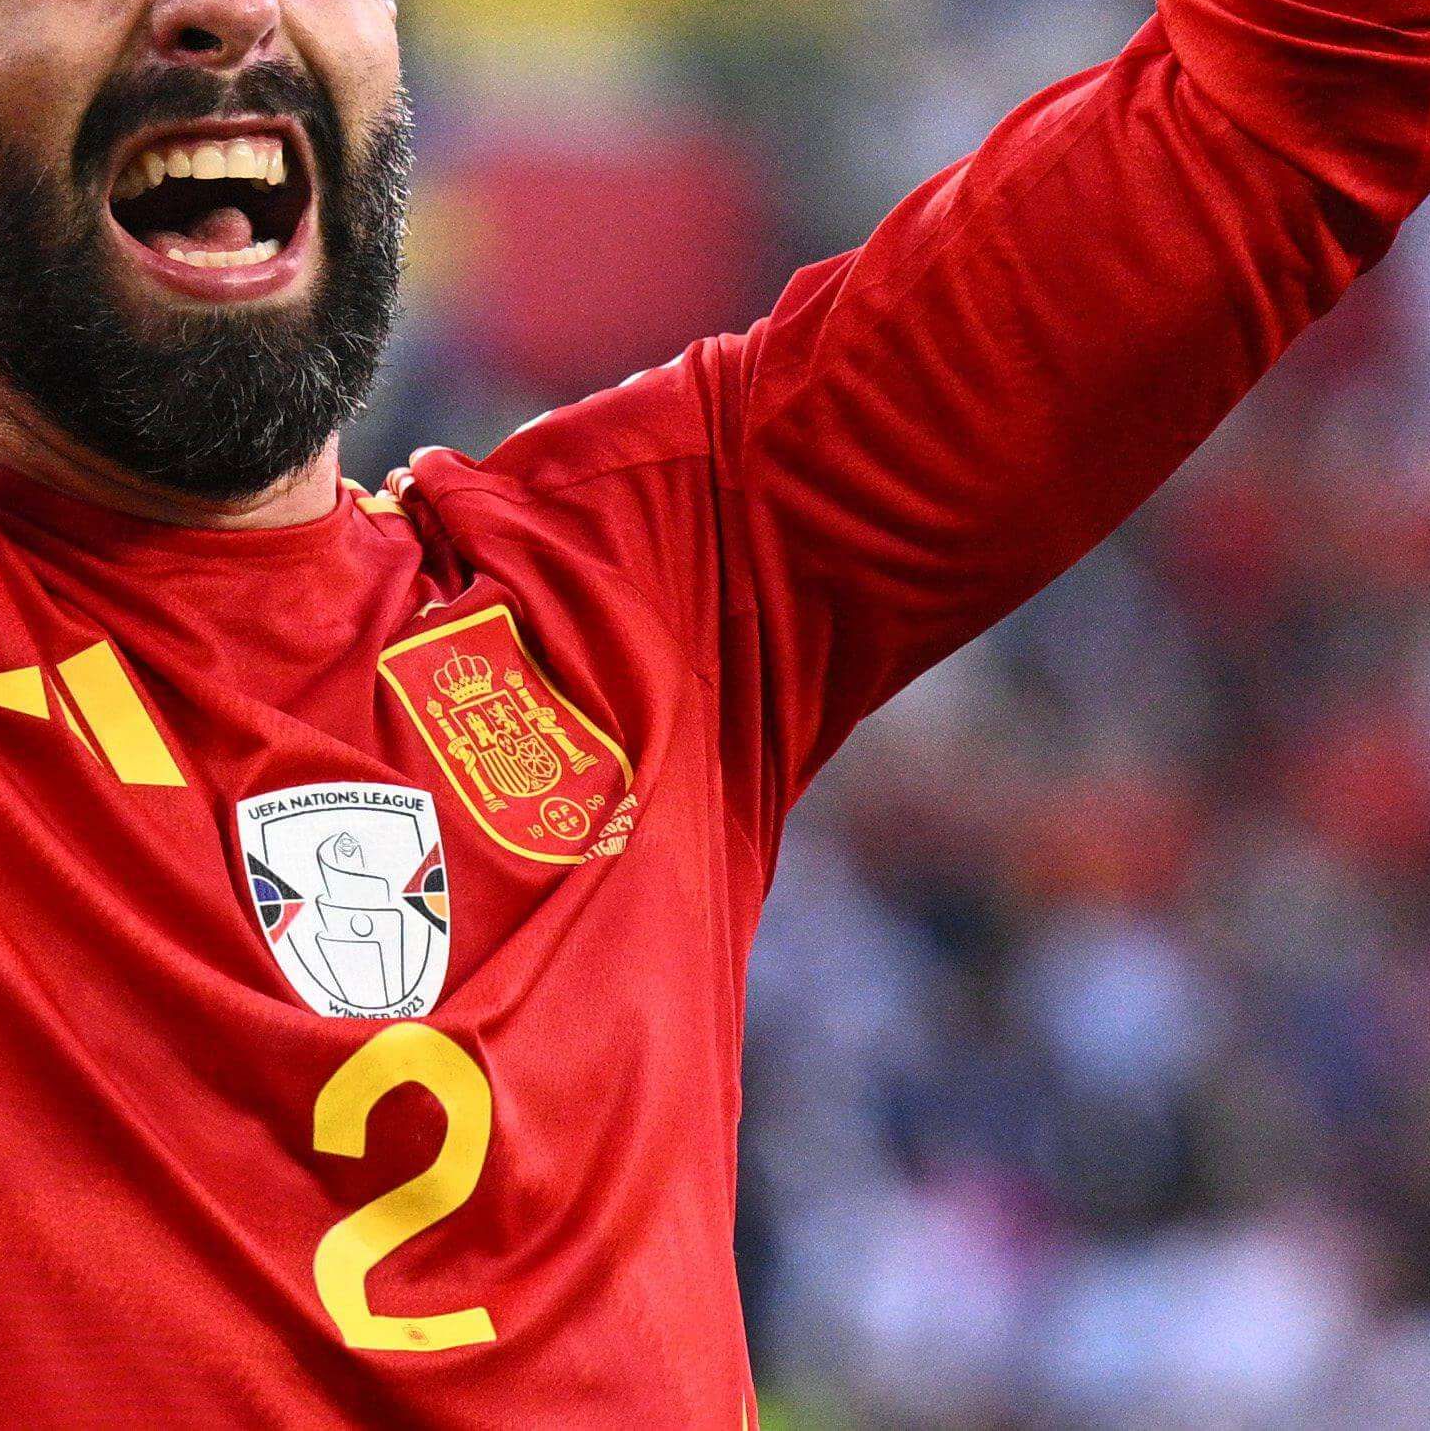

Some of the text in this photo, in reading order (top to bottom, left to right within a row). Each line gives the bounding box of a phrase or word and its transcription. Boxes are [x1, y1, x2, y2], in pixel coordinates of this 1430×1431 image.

[248, 791, 425, 820] UEFA NATIONS LEAGUE
[585, 794, 605, 810] 09
[527, 824, 544, 840] 19
[393, 995, 425, 1018] 2023
[313, 1021, 497, 1351] 2
